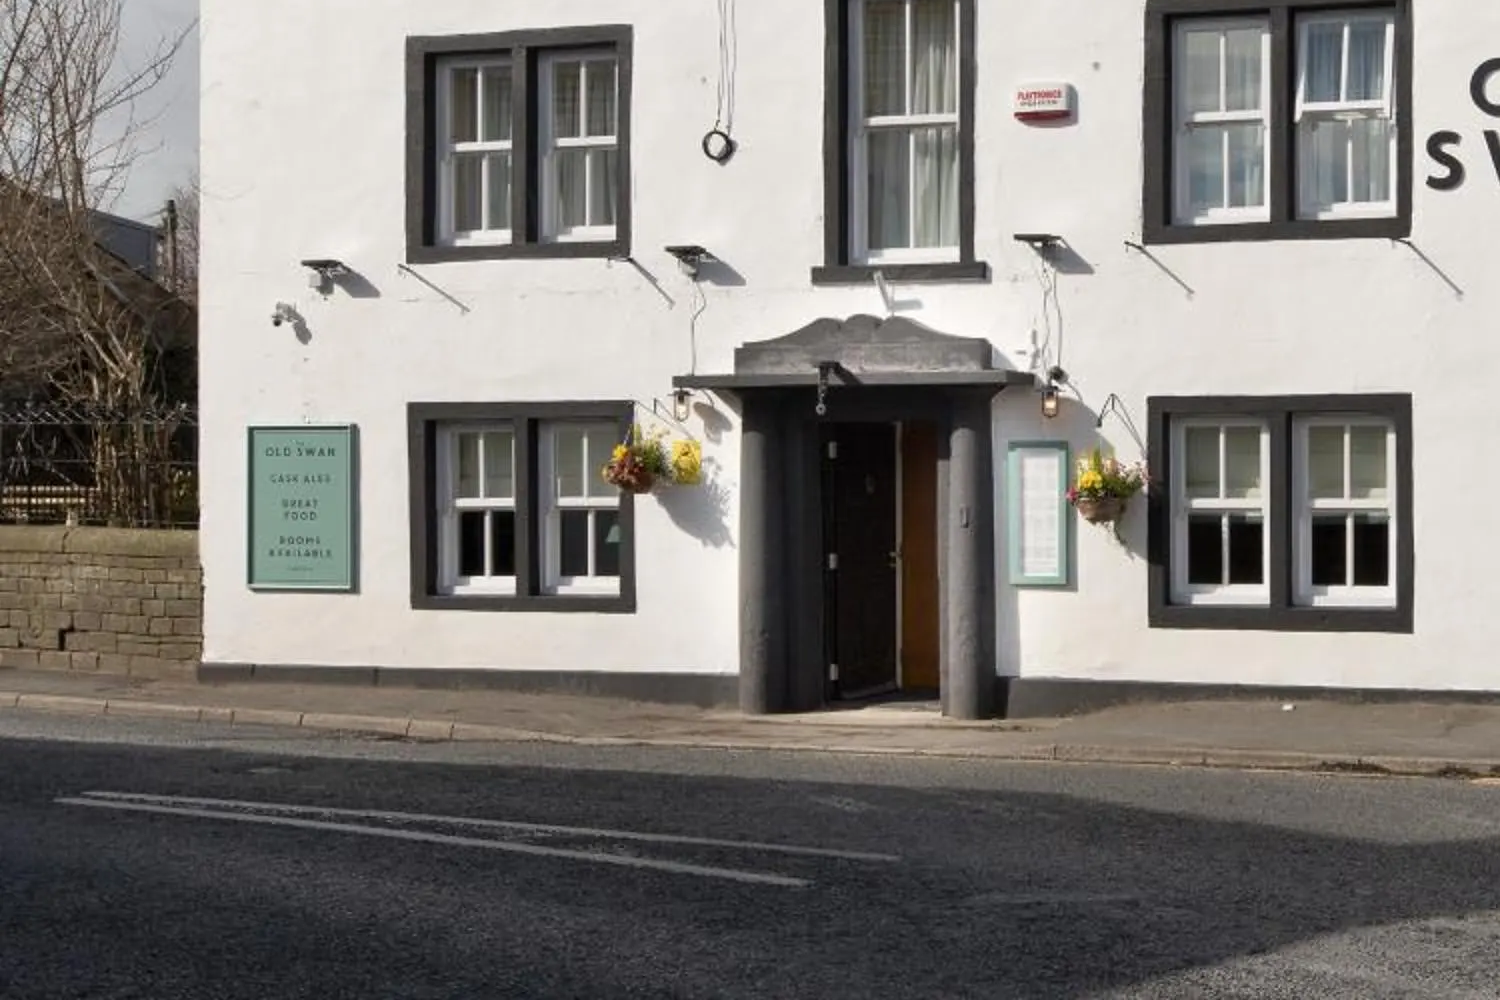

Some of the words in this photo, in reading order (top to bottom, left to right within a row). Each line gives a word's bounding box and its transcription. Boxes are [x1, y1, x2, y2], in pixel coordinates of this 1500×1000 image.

[265, 447, 292, 457] OLD
[297, 447, 336, 457] SWAN
[284, 511, 318, 521] FOOD
